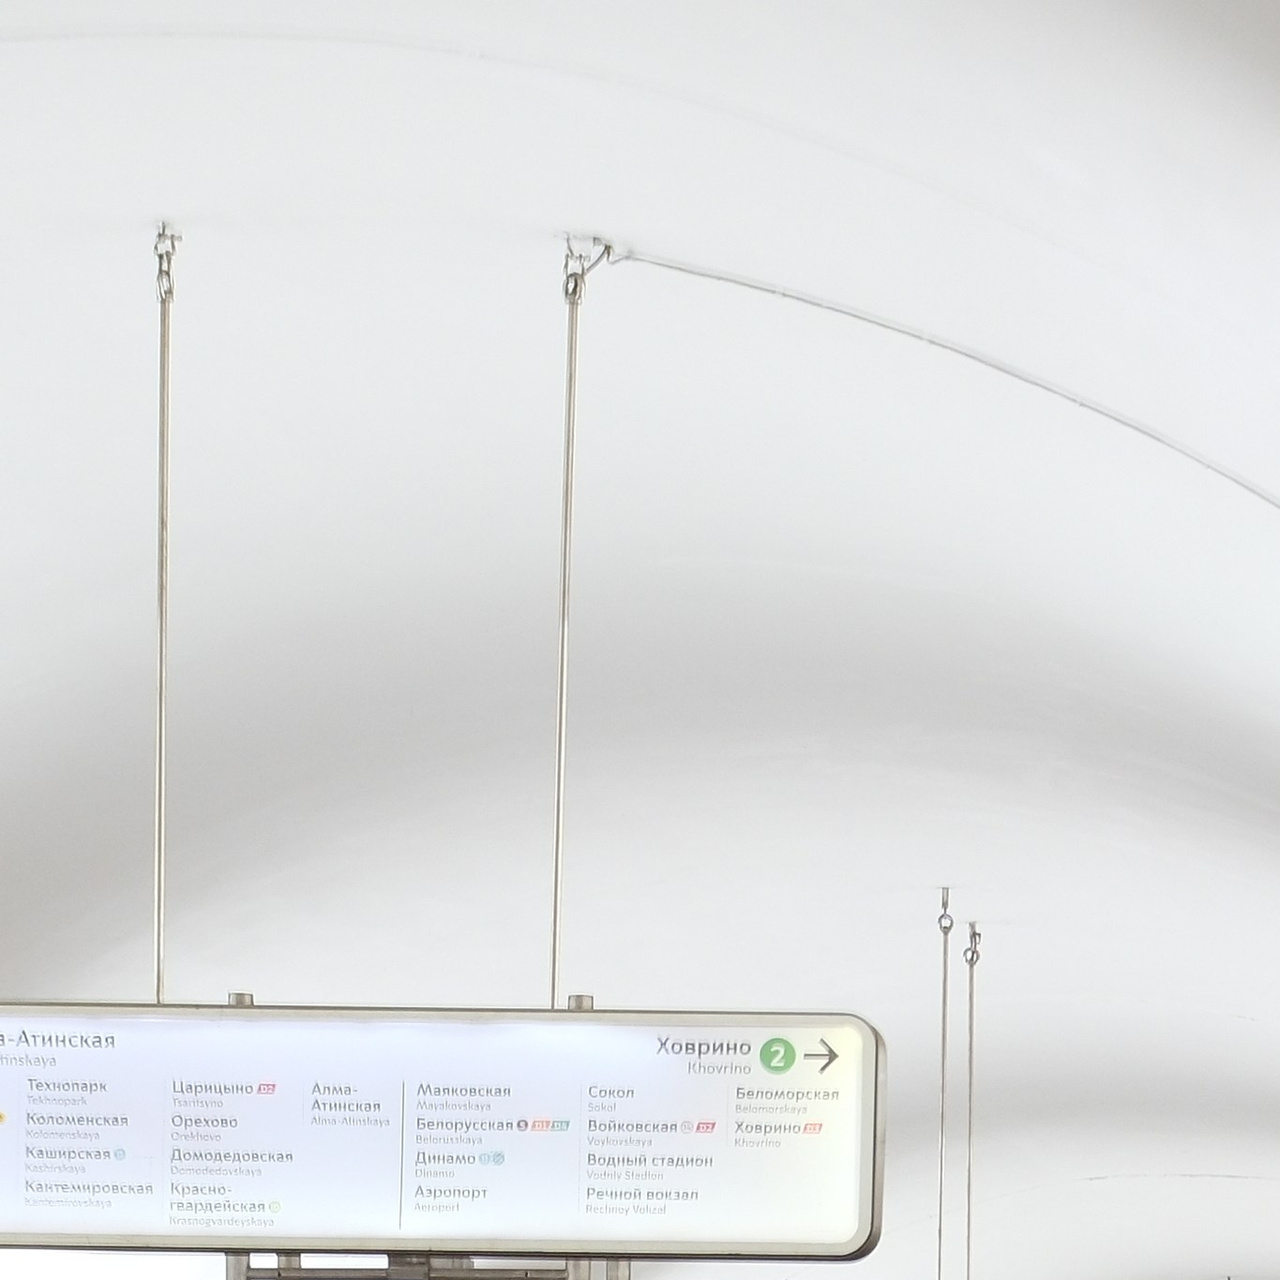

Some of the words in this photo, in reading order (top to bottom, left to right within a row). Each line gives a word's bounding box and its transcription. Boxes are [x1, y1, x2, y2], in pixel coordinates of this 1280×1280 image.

[656, 1037, 752, 1058] Ховрино
[768, 1046, 787, 1067] 2
[688, 1062, 752, 1075] Khovrino
[27, 1078, 108, 1094] Технопарк
[172, 1081, 254, 1096] Царицыно
[311, 1082, 358, 1096] Алма-
[416, 1083, 511, 1098] Маяковская
[588, 1085, 634, 1098] Сокол
[735, 1087, 840, 1102] Беломорская
[311, 1099, 381, 1112] Атинская
[26, 1112, 129, 1127] Коломенская
[171, 1115, 238, 1129] Орехово
[416, 1117, 514, 1134] Белорусская
[588, 1119, 678, 1134] Войковская
[734, 1121, 801, 1137] Ховрино
[25, 1146, 111, 1162] Каширская
[170, 1149, 293, 1164] Домодедовская
[414, 1151, 476, 1166] Динамо
[587, 1153, 647, 1168] Водный
[652, 1156, 713, 1168] стадион
[25, 1180, 153, 1196] Кантемировская
[170, 1183, 232, 1196] Красно-
[414, 1185, 488, 1201] Аэропорт
[586, 1187, 642, 1200] Речной
[646, 1190, 699, 1200] вокзал
[169, 1200, 266, 1215] гвардейская
